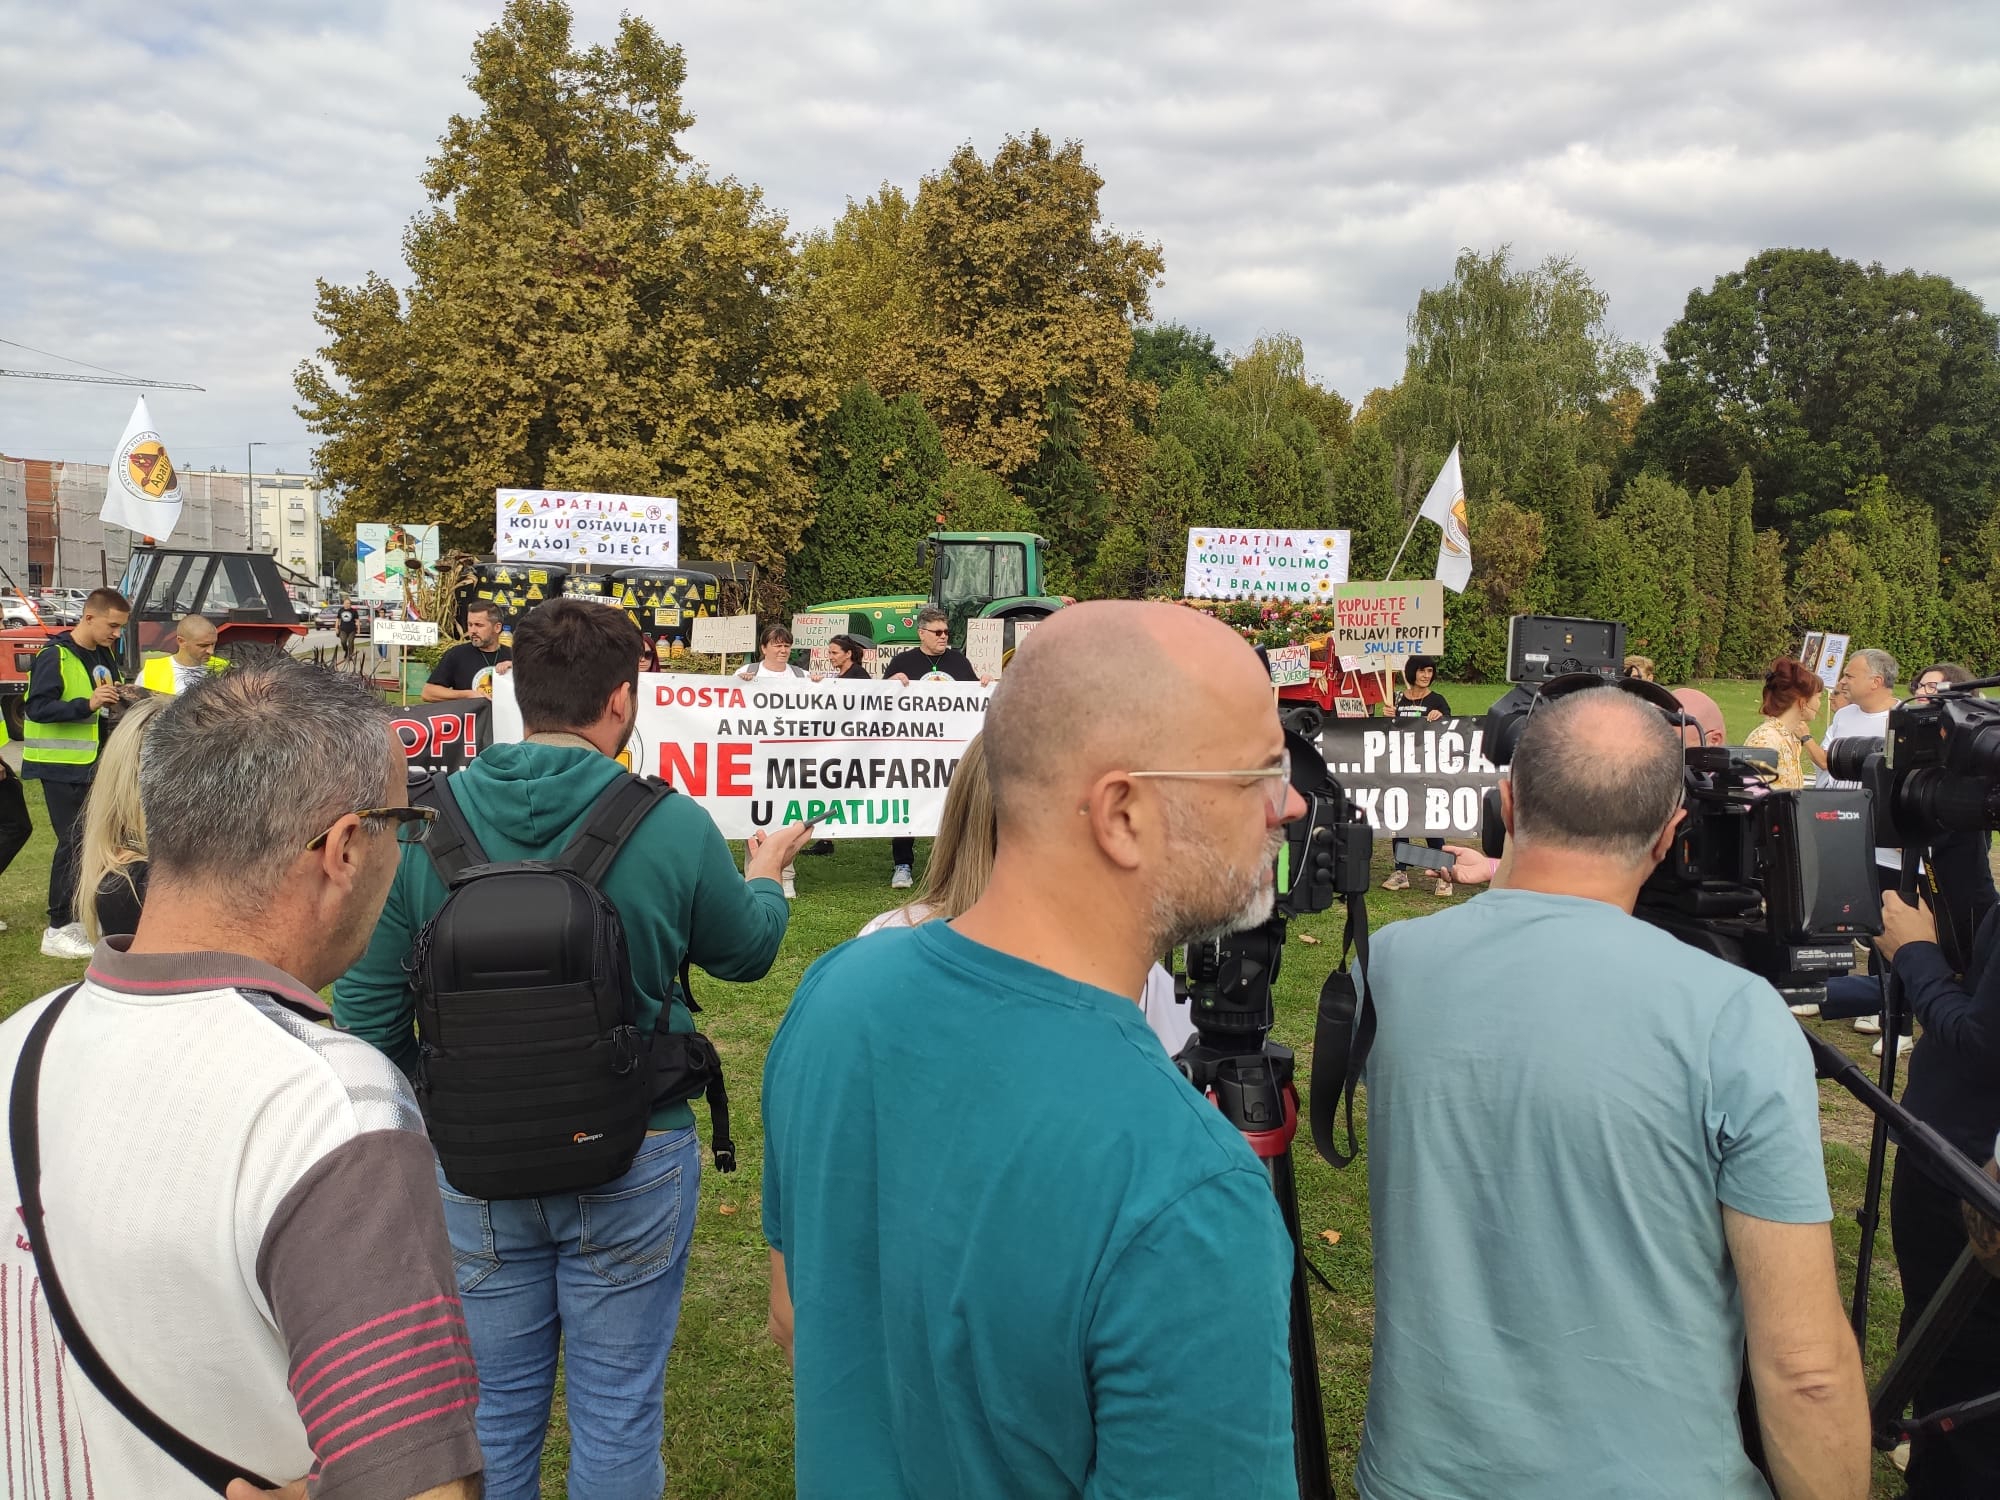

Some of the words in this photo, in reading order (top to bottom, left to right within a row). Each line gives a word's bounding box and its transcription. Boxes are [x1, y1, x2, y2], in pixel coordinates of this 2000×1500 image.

[540, 497, 628, 512] APATIJA
[510, 517, 549, 529] KOJU
[554, 518, 571, 529] VI
[577, 519, 667, 535] OSTAVLJATE
[518, 535, 570, 549] NAŠOJ
[597, 542, 650, 555] DJECI
[1218, 534, 1293, 547] APATIJA
[1199, 553, 1235, 565] KOJU
[1242, 555, 1260, 566] MI
[1268, 557, 1329, 570] VOLIMO
[1216, 577, 1221, 588] I
[1230, 578, 1311, 593] BRANIMO
[1338, 596, 1407, 612] KUPUJETE
[1415, 596, 1420, 610] I
[376, 621, 396, 630] NIJE
[1338, 612, 1402, 628] TRUJETE
[806, 626, 832, 635] UZETI
[1339, 627, 1390, 641] PRLJAVI
[1395, 625, 1442, 640] PROFIT
[1364, 640, 1424, 655] SNUJETE
[655, 685, 747, 709] DOSTA
[753, 692, 838, 710] ODLUKA
[843, 694, 856, 710] U
[860, 695, 893, 711] IME
[897, 695, 991, 712] GRAĐANA
[717, 719, 732, 736] A
[738, 719, 769, 736] NA
[773, 716, 836, 737] ŠTETU
[840, 720, 945, 738] GRAĐANA!
[659, 741, 753, 797] NE
[751, 799, 774, 827] U
[781, 798, 911, 827] APATIJI!
[1925, 862, 1939, 894] Nikon
